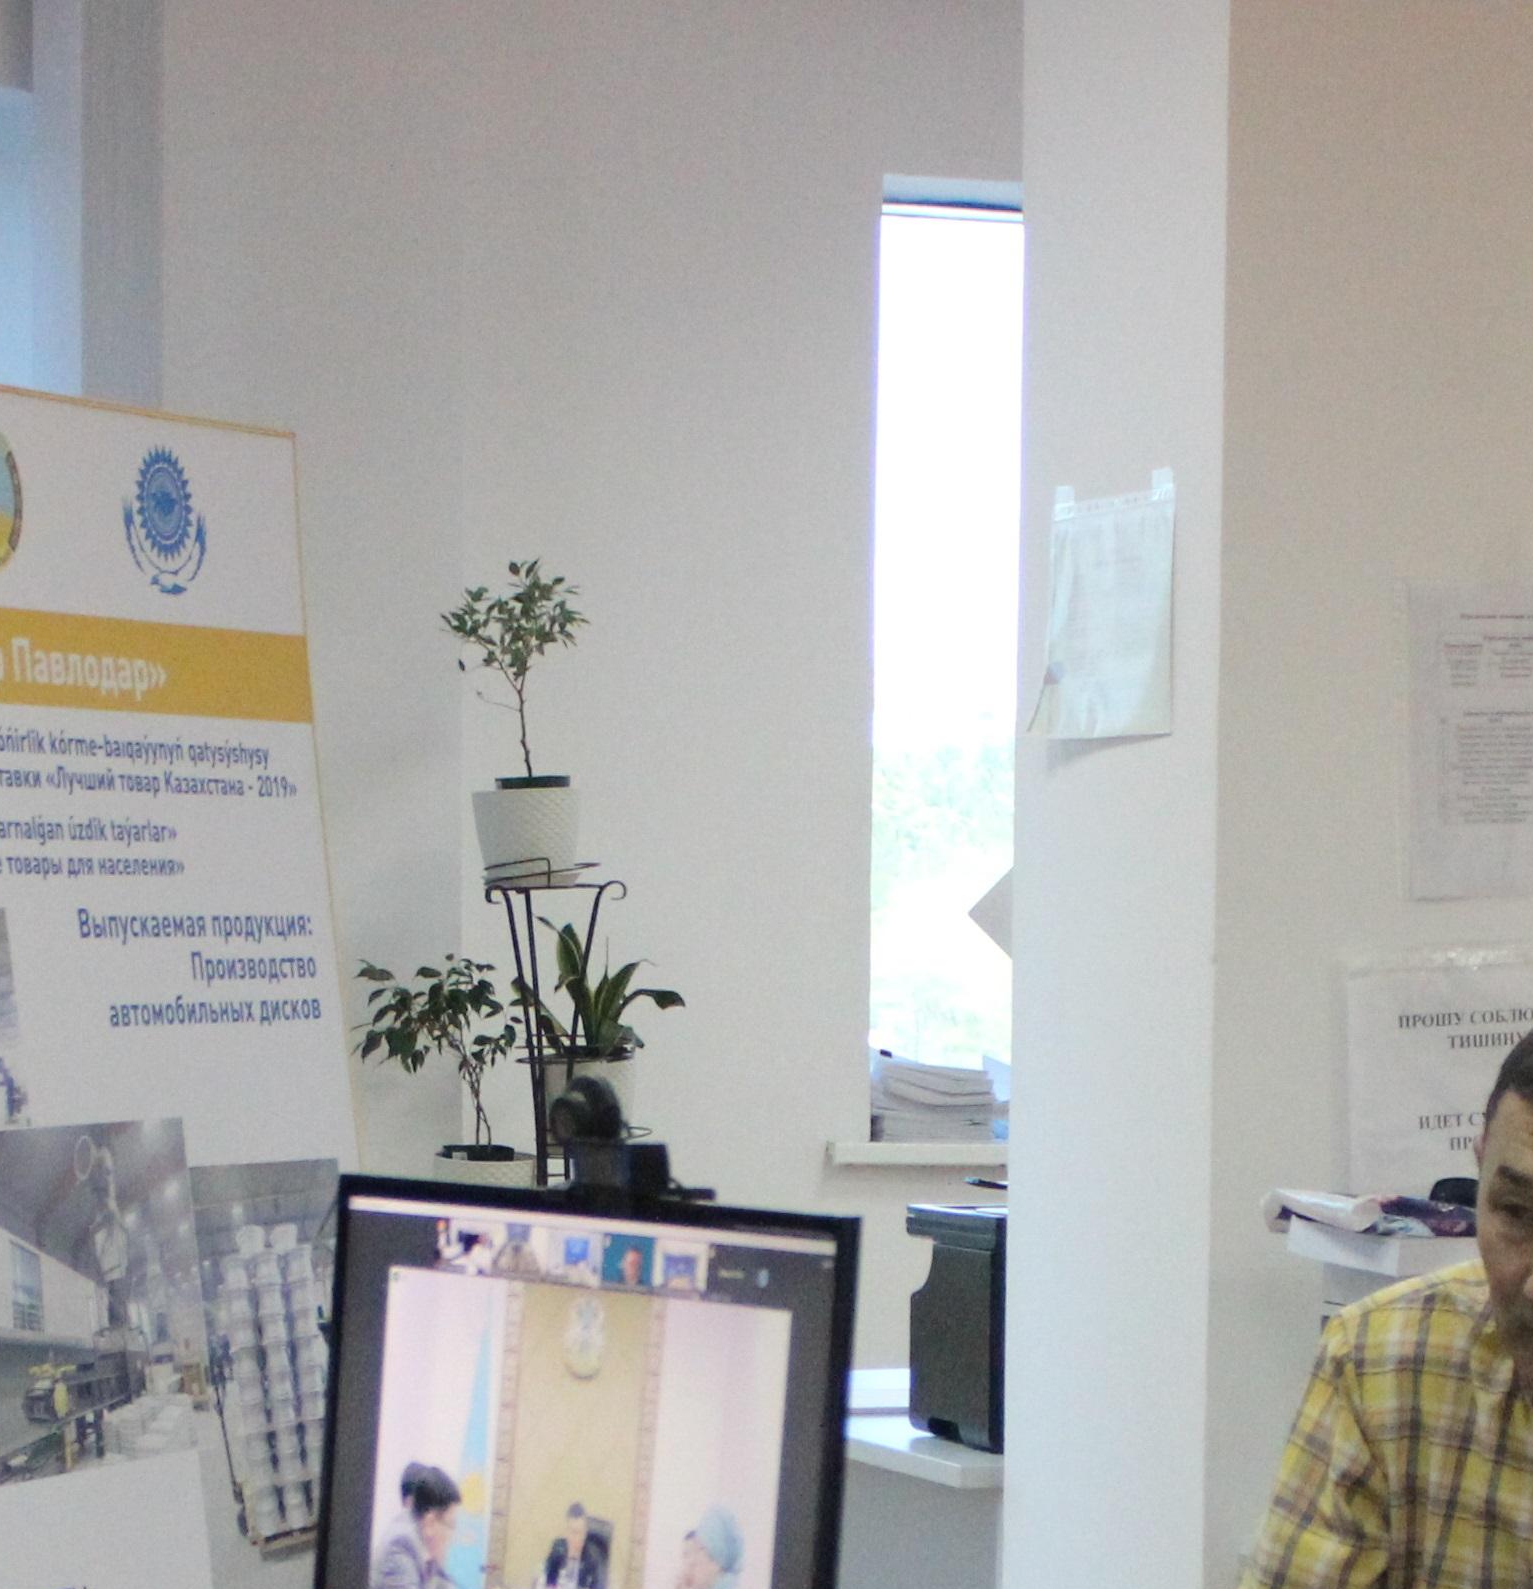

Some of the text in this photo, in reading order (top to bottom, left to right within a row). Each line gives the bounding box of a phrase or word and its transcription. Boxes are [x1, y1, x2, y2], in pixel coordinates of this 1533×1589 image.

[11, 636, 167, 701] Павлодар»
[46, 765, 116, 795] «Лучший
[118, 774, 161, 798] товар
[164, 771, 244, 796] Казахстана
[257, 775, 297, 798] 2019»
[6, 856, 63, 880] товары
[67, 857, 94, 878] для
[98, 857, 185, 877] населения»
[77, 907, 313, 946] Выпускаемая продукция:
[190, 951, 317, 987] Производство
[109, 995, 322, 1028] автомобильных дисков
[1398, 1011, 1462, 1029] ПРОШУ
[1419, 1112, 1463, 1130] ИДЕТ
